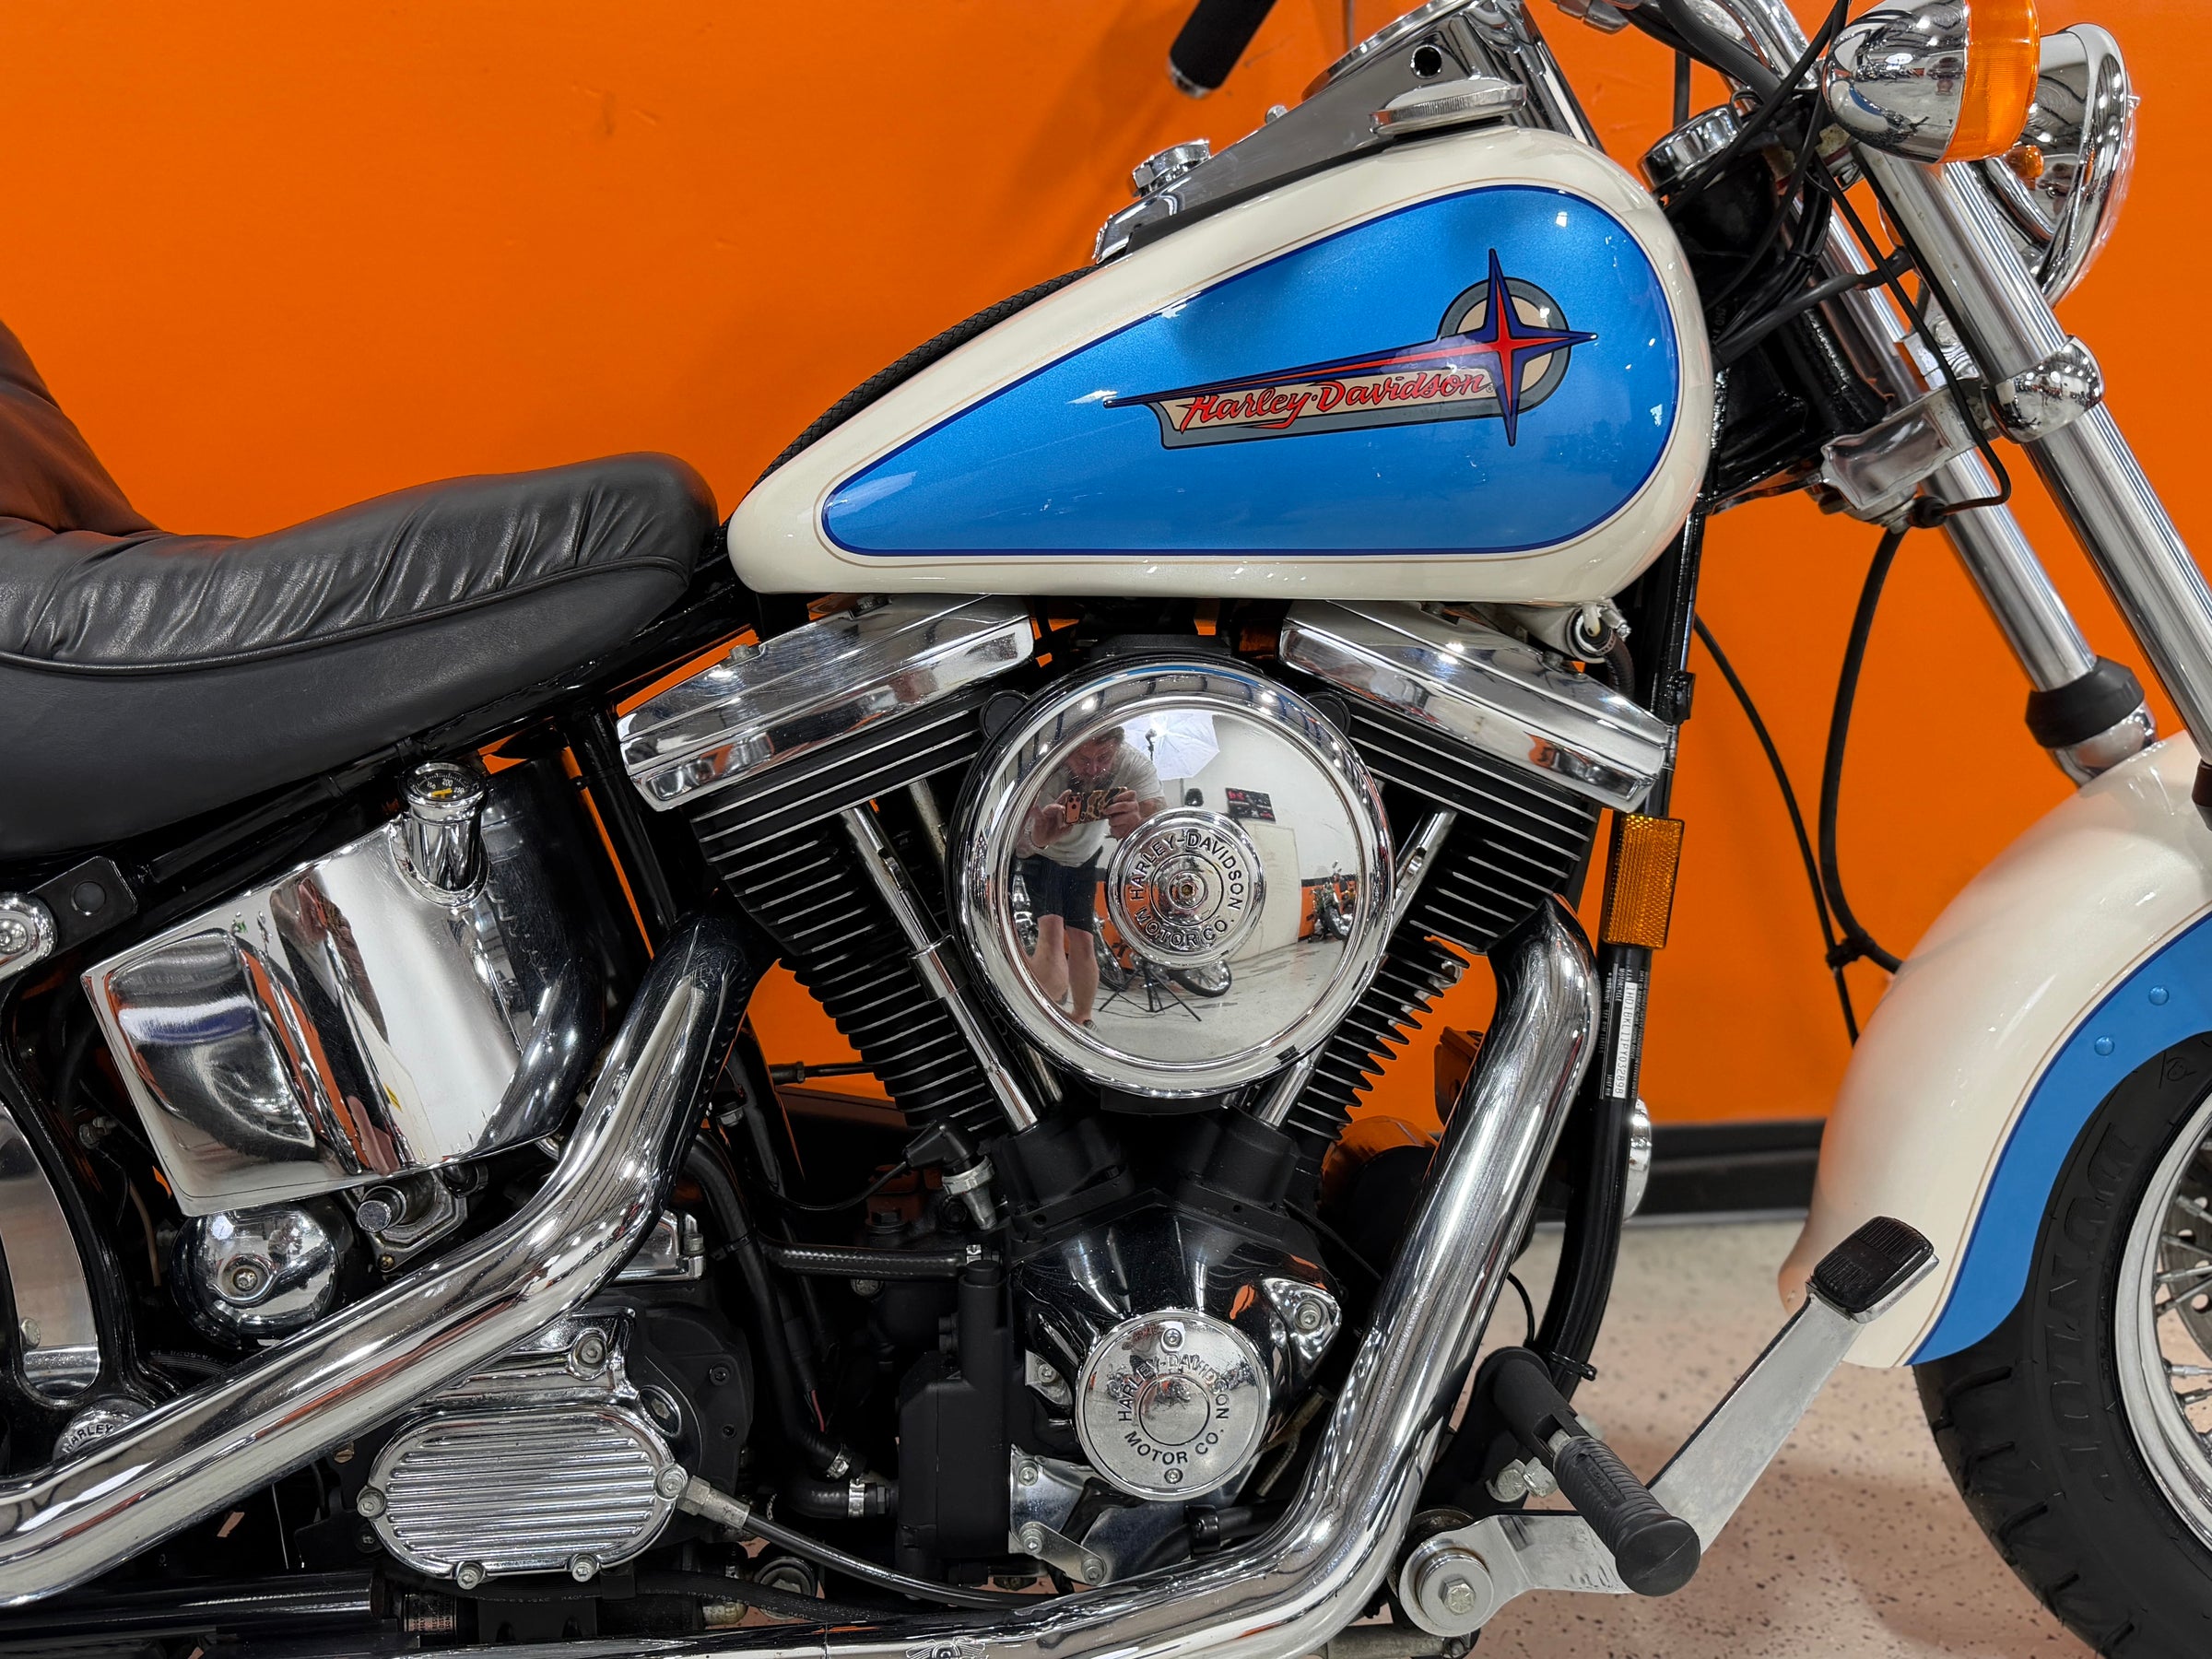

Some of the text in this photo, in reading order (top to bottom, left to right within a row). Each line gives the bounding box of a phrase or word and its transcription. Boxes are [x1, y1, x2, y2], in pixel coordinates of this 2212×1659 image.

[442, 778, 453, 787] 200
[1130, 831, 1244, 911] HARLEY-DAVIDSON
[1135, 906, 1197, 947] MOTOR
[1118, 1353, 1230, 1422] HARLEY-DAVIDSON
[62, 1424, 113, 1453] HARLEY
[1124, 1429, 1224, 1465] MOTOR CO.
